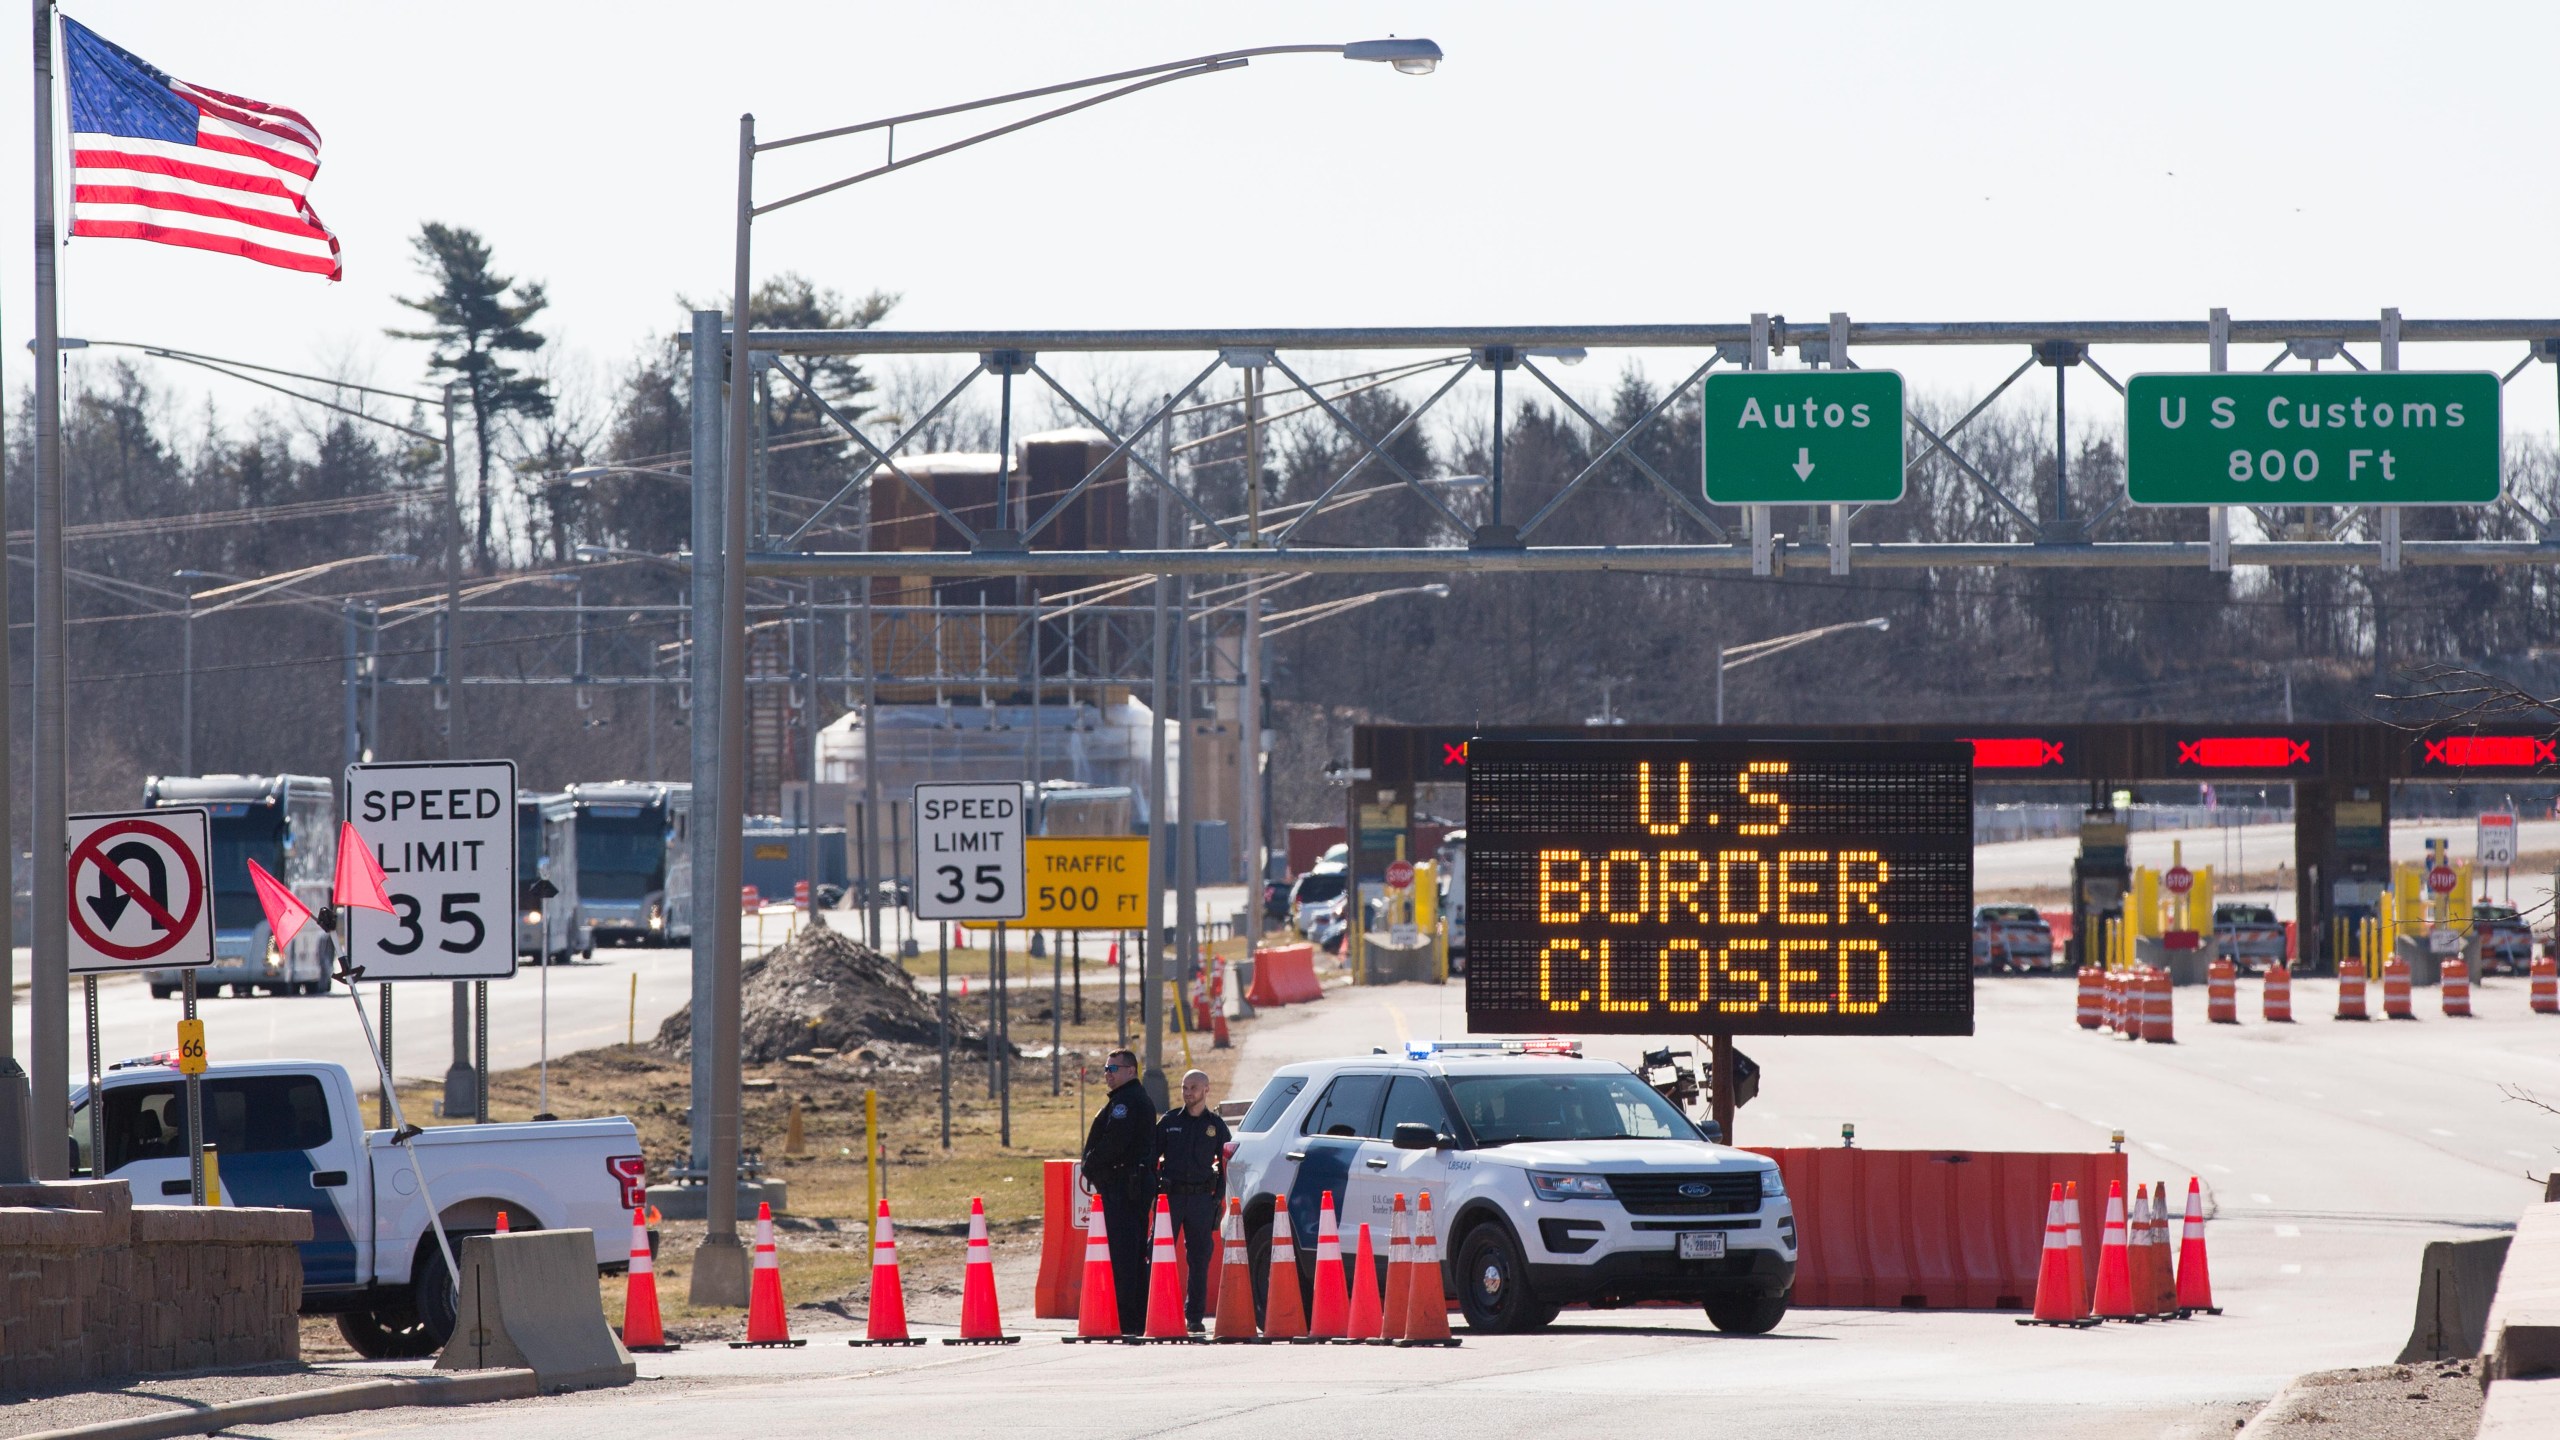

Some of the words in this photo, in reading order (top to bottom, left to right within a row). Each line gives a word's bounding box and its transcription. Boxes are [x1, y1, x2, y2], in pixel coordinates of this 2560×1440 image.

[1737, 396, 1871, 429] Autos
[2160, 397, 2187, 429] U
[2209, 396, 2236, 429] S
[2266, 396, 2465, 429] Customs
[2228, 449, 2320, 482] 800
[2349, 449, 2396, 481] Ft
[362, 788, 501, 822] SPEED
[924, 799, 1014, 820] SPEED
[1639, 762, 1789, 835] U.S
[378, 840, 485, 873] LIMIT
[934, 832, 1004, 852] LIMIT
[2484, 849, 2509, 862] 40
[1044, 855, 1126, 873] TRAFFIC
[1388, 869, 1413, 882] STOP
[935, 865, 1005, 904] 35
[1540, 850, 1888, 924] BORDER
[2167, 873, 2192, 888] STOP
[2430, 873, 2455, 888] STOP
[1039, 886, 1099, 911] 500
[1117, 894, 1139, 912] FT
[377, 892, 486, 956] 35
[1540, 938, 1888, 1013] CLOSED
[182, 1038, 203, 1058] 66
[1687, 1185, 1706, 1194] Ford
